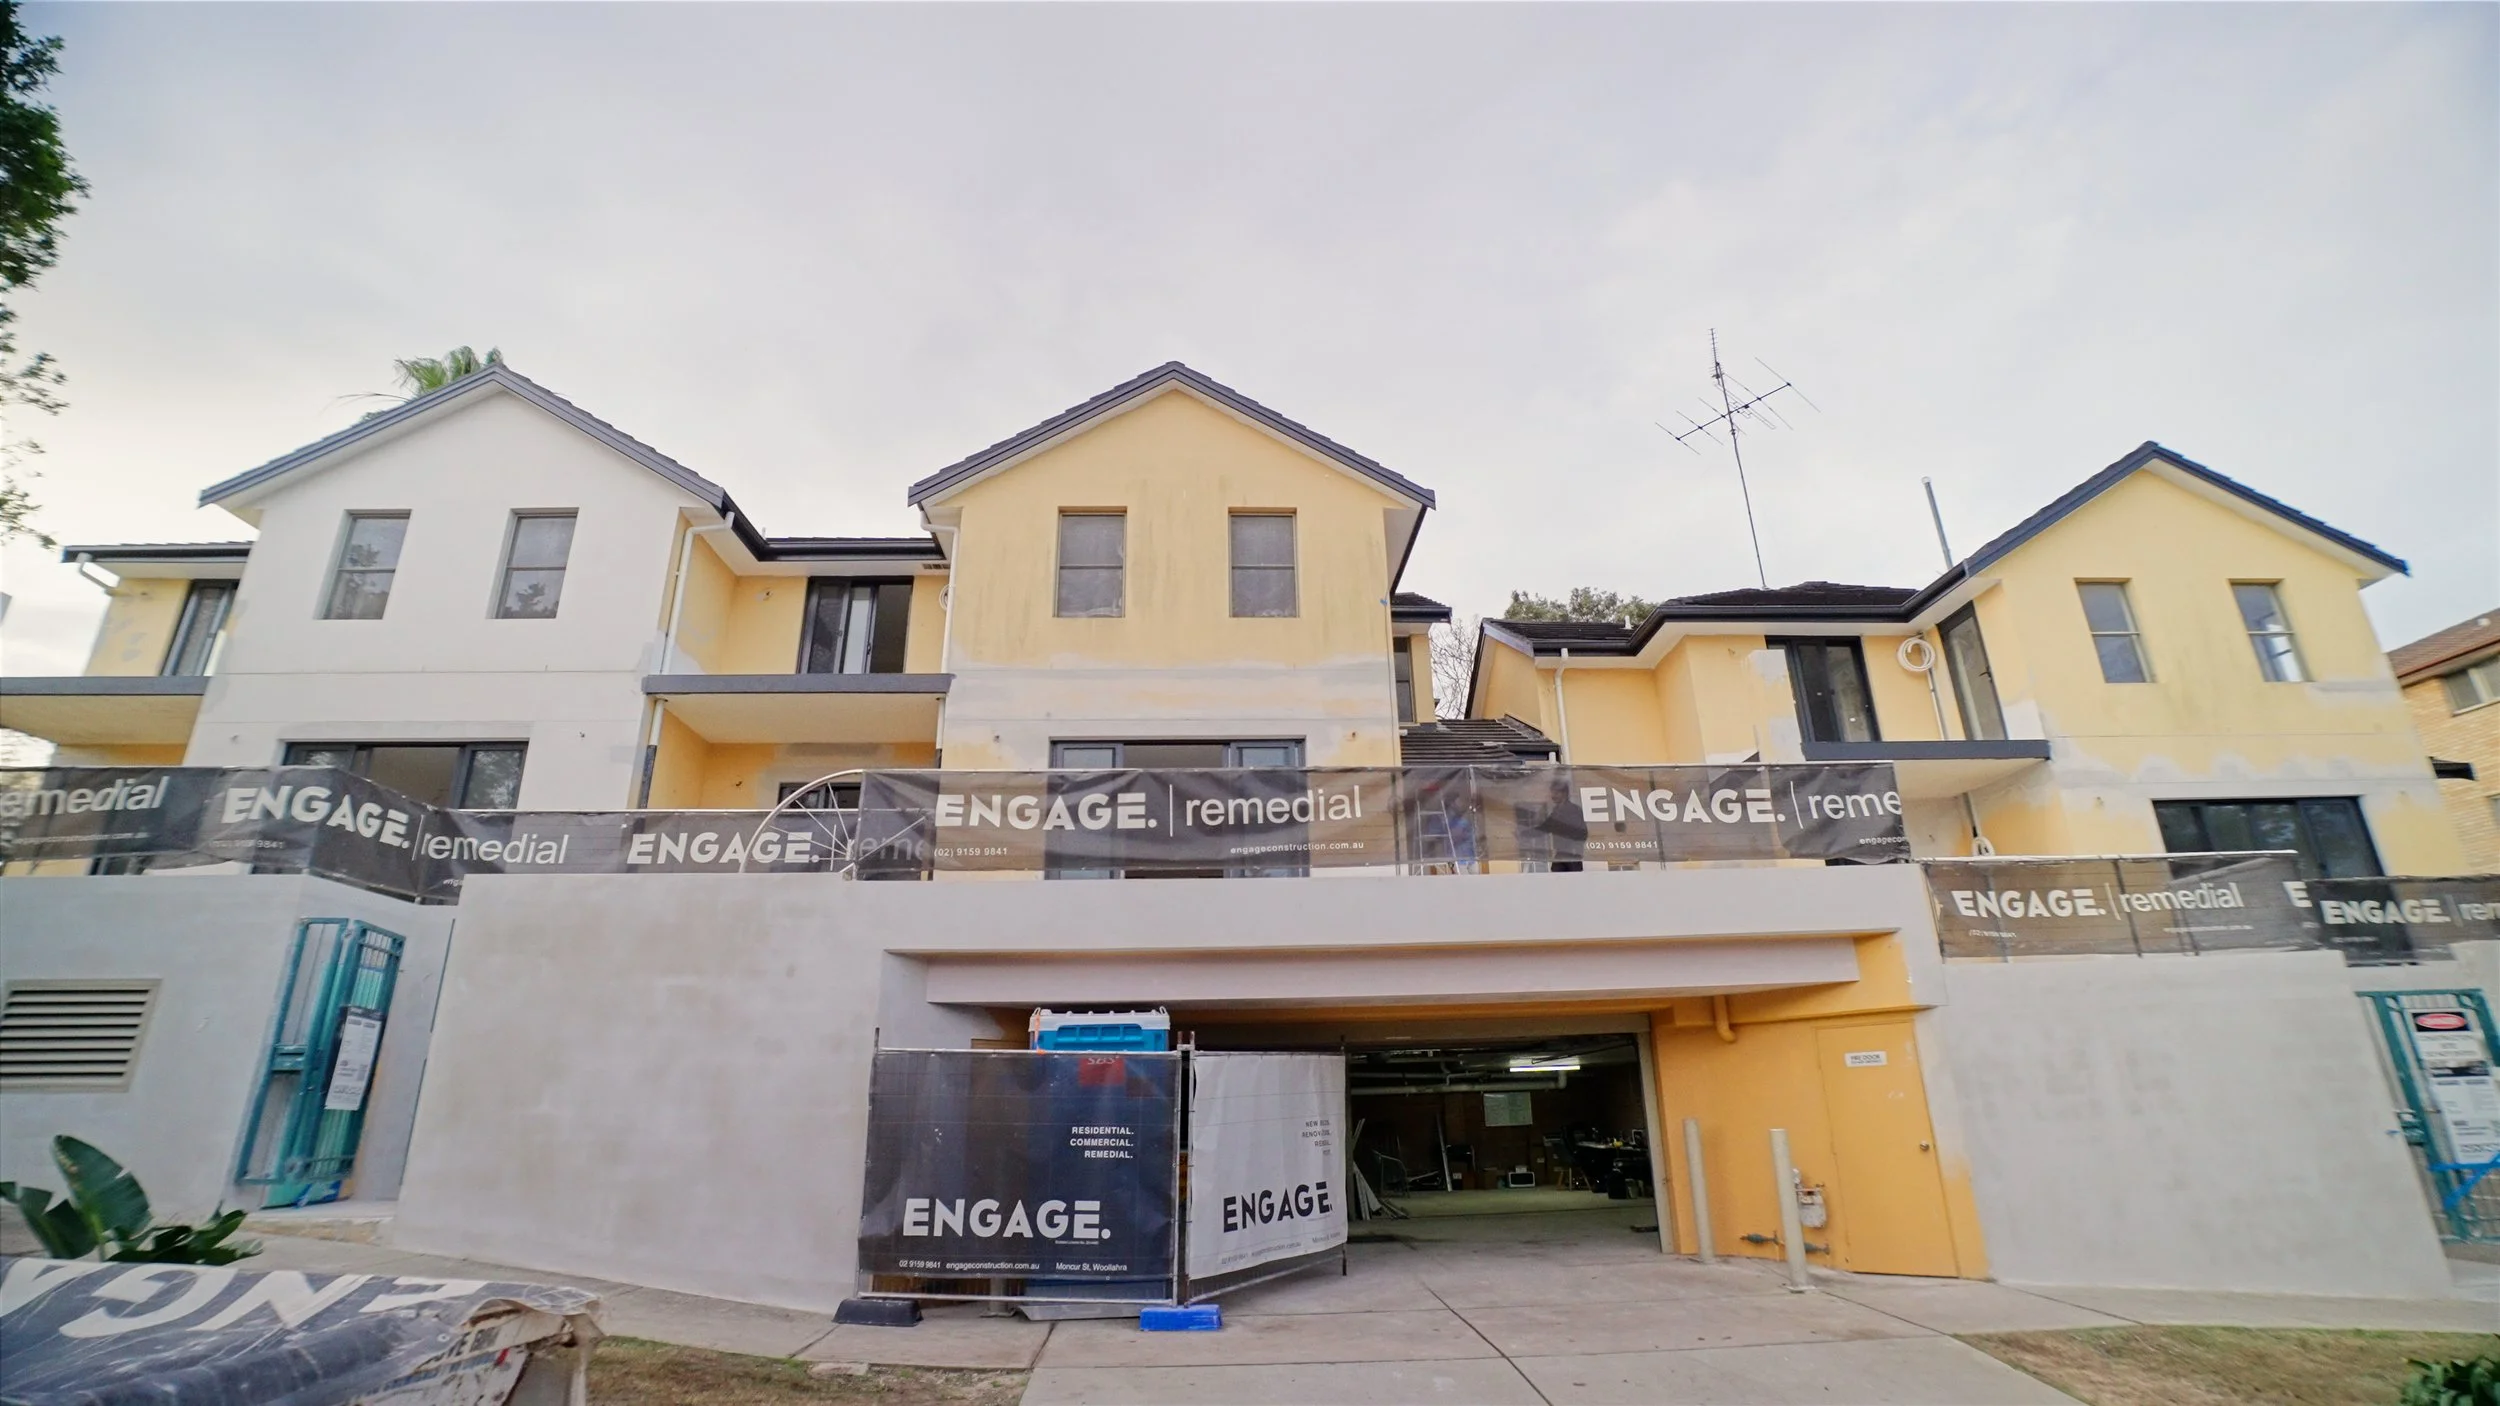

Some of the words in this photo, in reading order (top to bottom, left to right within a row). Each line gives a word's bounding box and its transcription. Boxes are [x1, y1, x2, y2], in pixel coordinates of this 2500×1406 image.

[0, 776, 170, 816] emedial
[1580, 787, 1786, 823] ENGAGE.
[1808, 791, 1902, 819] reme
[935, 793, 1157, 830] ENGAGE.
[1186, 785, 1362, 826] remedial
[221, 785, 410, 849] ENGAGE.
[421, 833, 569, 864] remedial
[626, 832, 820, 864] ENGAGE.
[934, 848, 954, 857] (02)
[957, 847, 981, 856] 9159
[984, 847, 1008, 856] 9841
[1230, 842, 1364, 855] engageconstruction.com.au
[1586, 842, 1606, 850] (02)
[1608, 841, 1632, 849] 9159
[1635, 841, 1658, 849] 9841
[1951, 889, 2107, 918] ENGAGE.
[2119, 881, 2244, 913] remedial
[1071, 1126, 1134, 1135] RESIDENTIAL.
[1069, 1138, 1134, 1146] COMMERCIAL.
[1084, 1150, 1133, 1158] REMEDIAL.
[903, 1198, 1111, 1239] ENGAGE.
[899, 1260, 908, 1268] 02
[945, 1261, 1040, 1271] engageconstruction.com.au
[1055, 1262, 1081, 1270] Moncur
[1093, 1263, 1128, 1271] Woollahra
